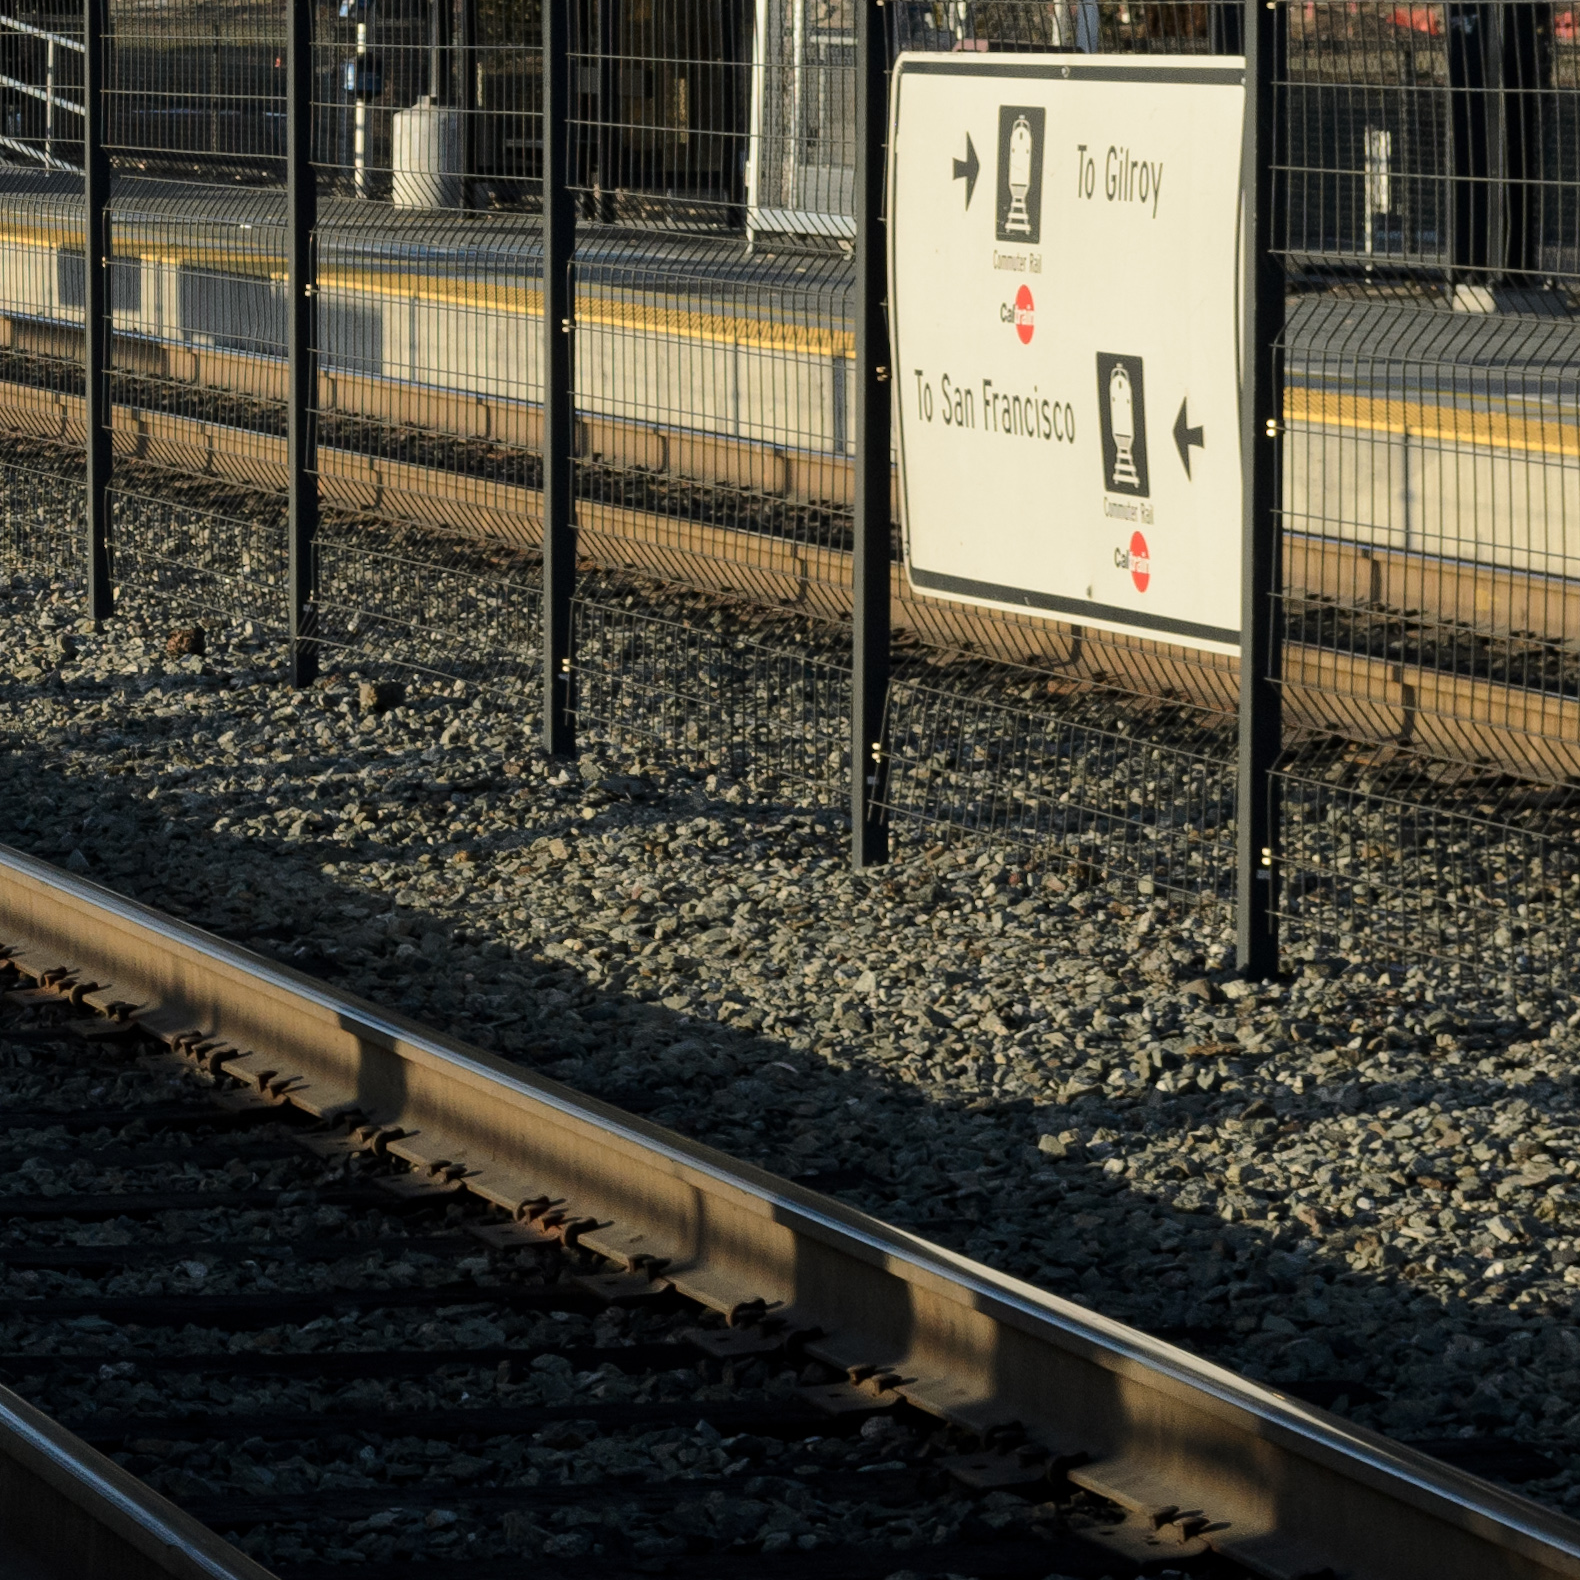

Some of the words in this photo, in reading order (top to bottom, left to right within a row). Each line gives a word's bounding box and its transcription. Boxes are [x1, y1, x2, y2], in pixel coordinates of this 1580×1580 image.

[1076, 144, 1096, 201] To
[1104, 146, 1163, 219] Gilroy
[992, 249, 1027, 272] Commuter
[1029, 252, 1042, 274] Rail
[999, 301, 1035, 327] Caltrain
[913, 369, 933, 423] To
[940, 372, 976, 430] San
[981, 377, 1076, 445] Francisco
[1103, 496, 1138, 522] Commuter
[1140, 502, 1154, 525] Rail
[1114, 546, 1151, 575] Caltrain
